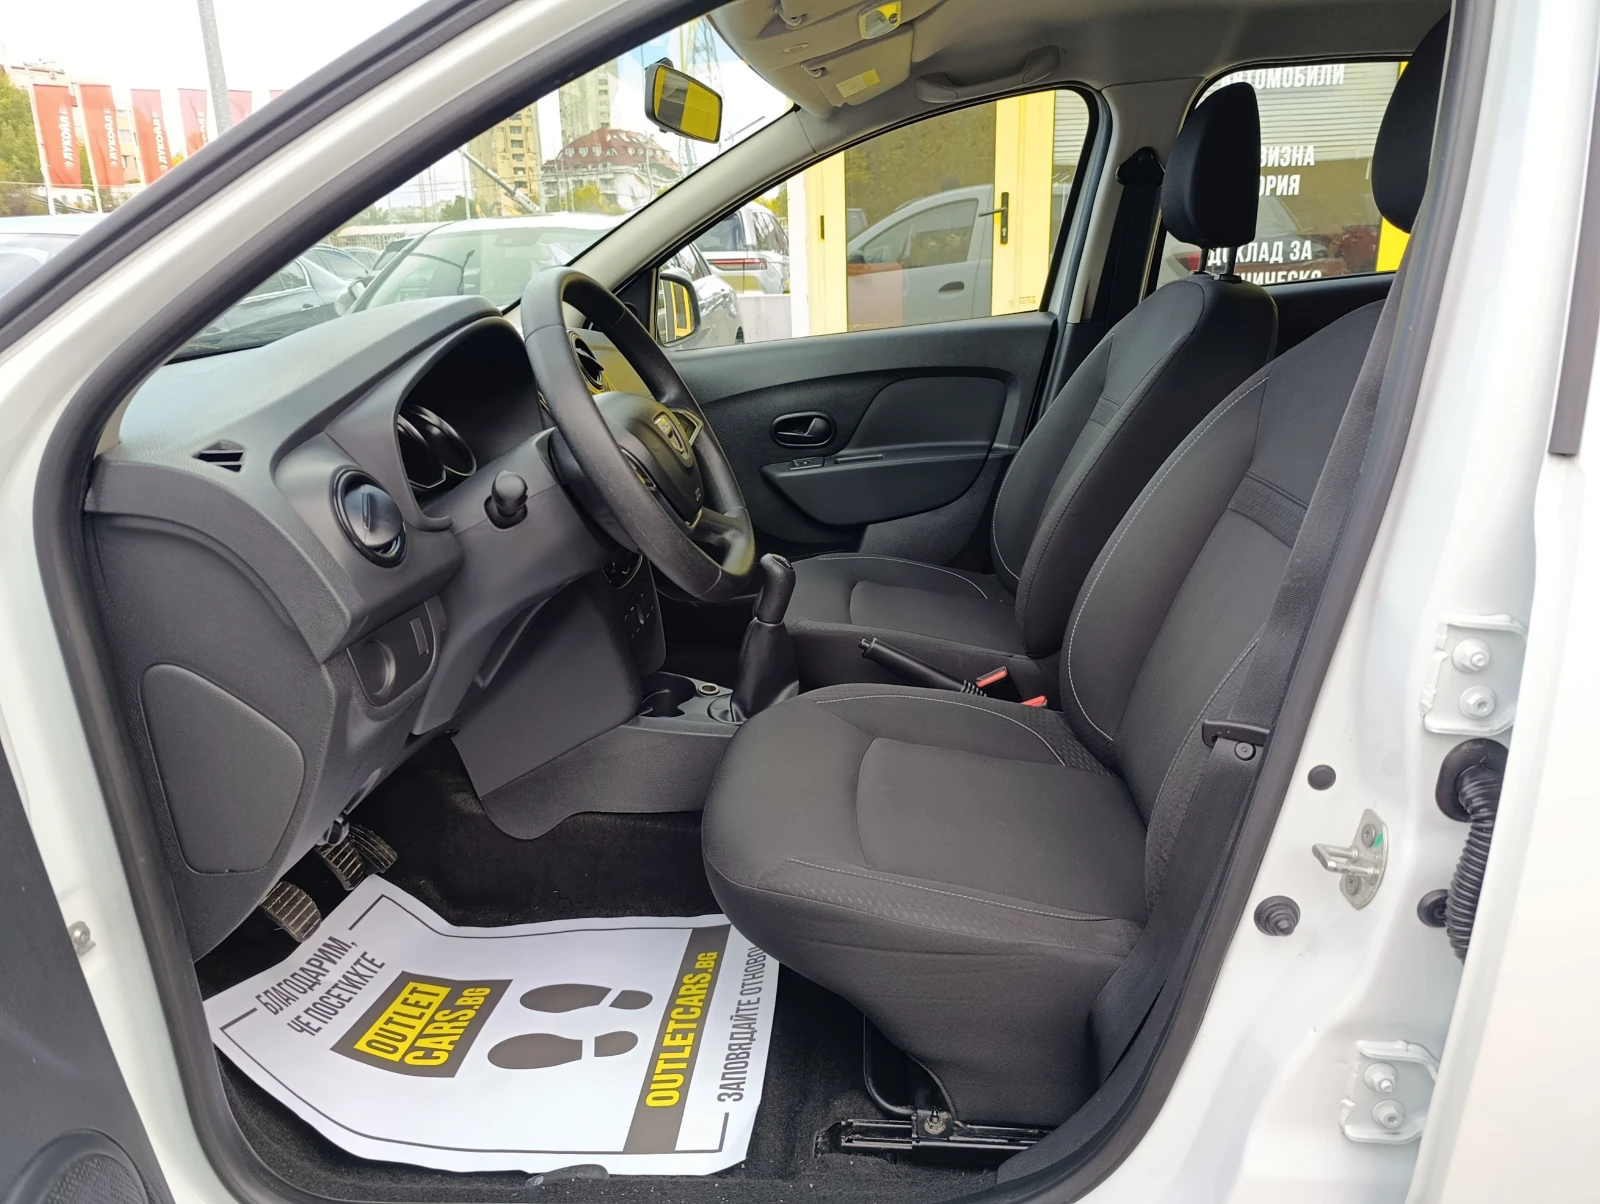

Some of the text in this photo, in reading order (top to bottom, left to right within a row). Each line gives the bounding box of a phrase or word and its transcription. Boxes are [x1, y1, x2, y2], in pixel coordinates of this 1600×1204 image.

[1289, 240, 1313, 261] ЗА
[255, 936, 358, 1016] БЛАГОДАРИМ,
[309, 951, 386, 1024] ПОСЕТИХТЕ
[365, 986, 448, 1055] OUTLET
[403, 987, 492, 1066] CARS.BG
[645, 951, 719, 1108] OUTLETCARS.BG
[717, 997, 761, 1103] ЗАПОВЯДАЙТЕ
